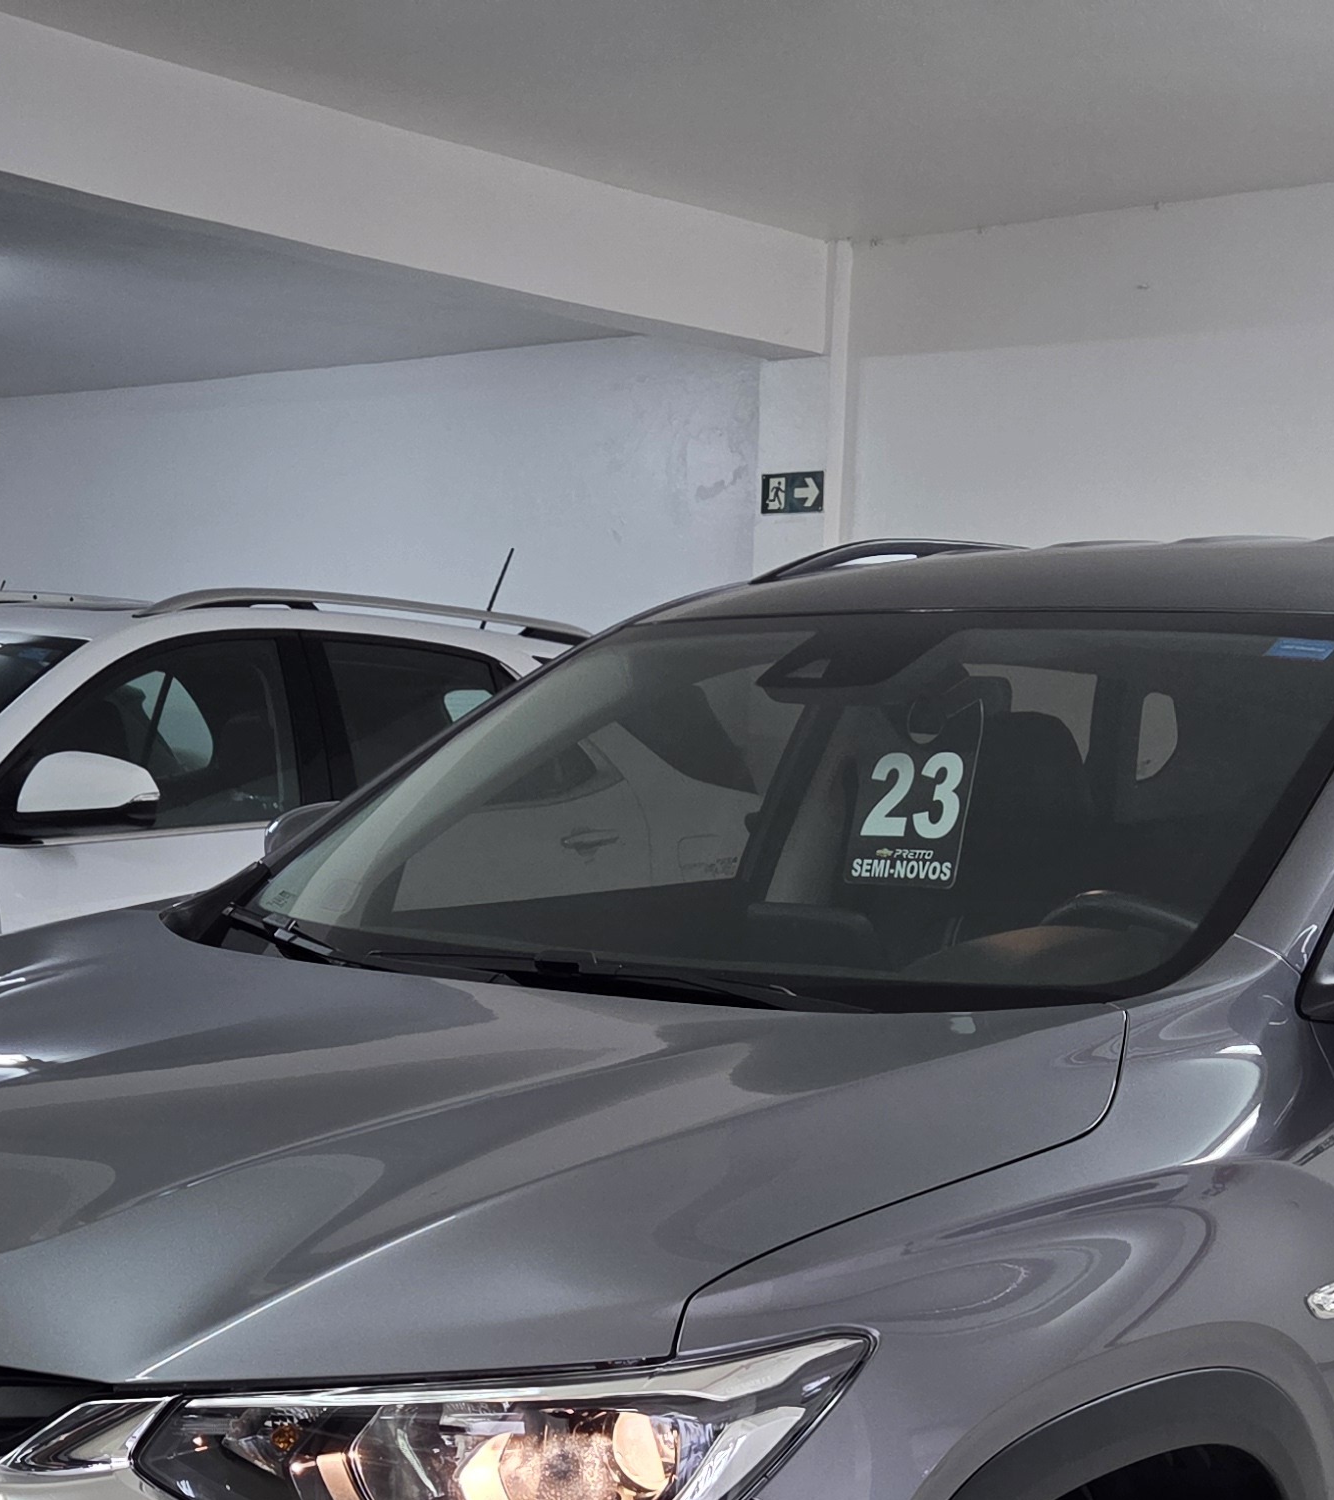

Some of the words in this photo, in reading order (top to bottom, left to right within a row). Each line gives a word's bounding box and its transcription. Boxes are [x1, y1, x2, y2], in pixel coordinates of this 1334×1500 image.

[860, 751, 964, 839] 23
[893, 848, 934, 860] PRETTO
[851, 858, 952, 881] SEMI-NOVOS
